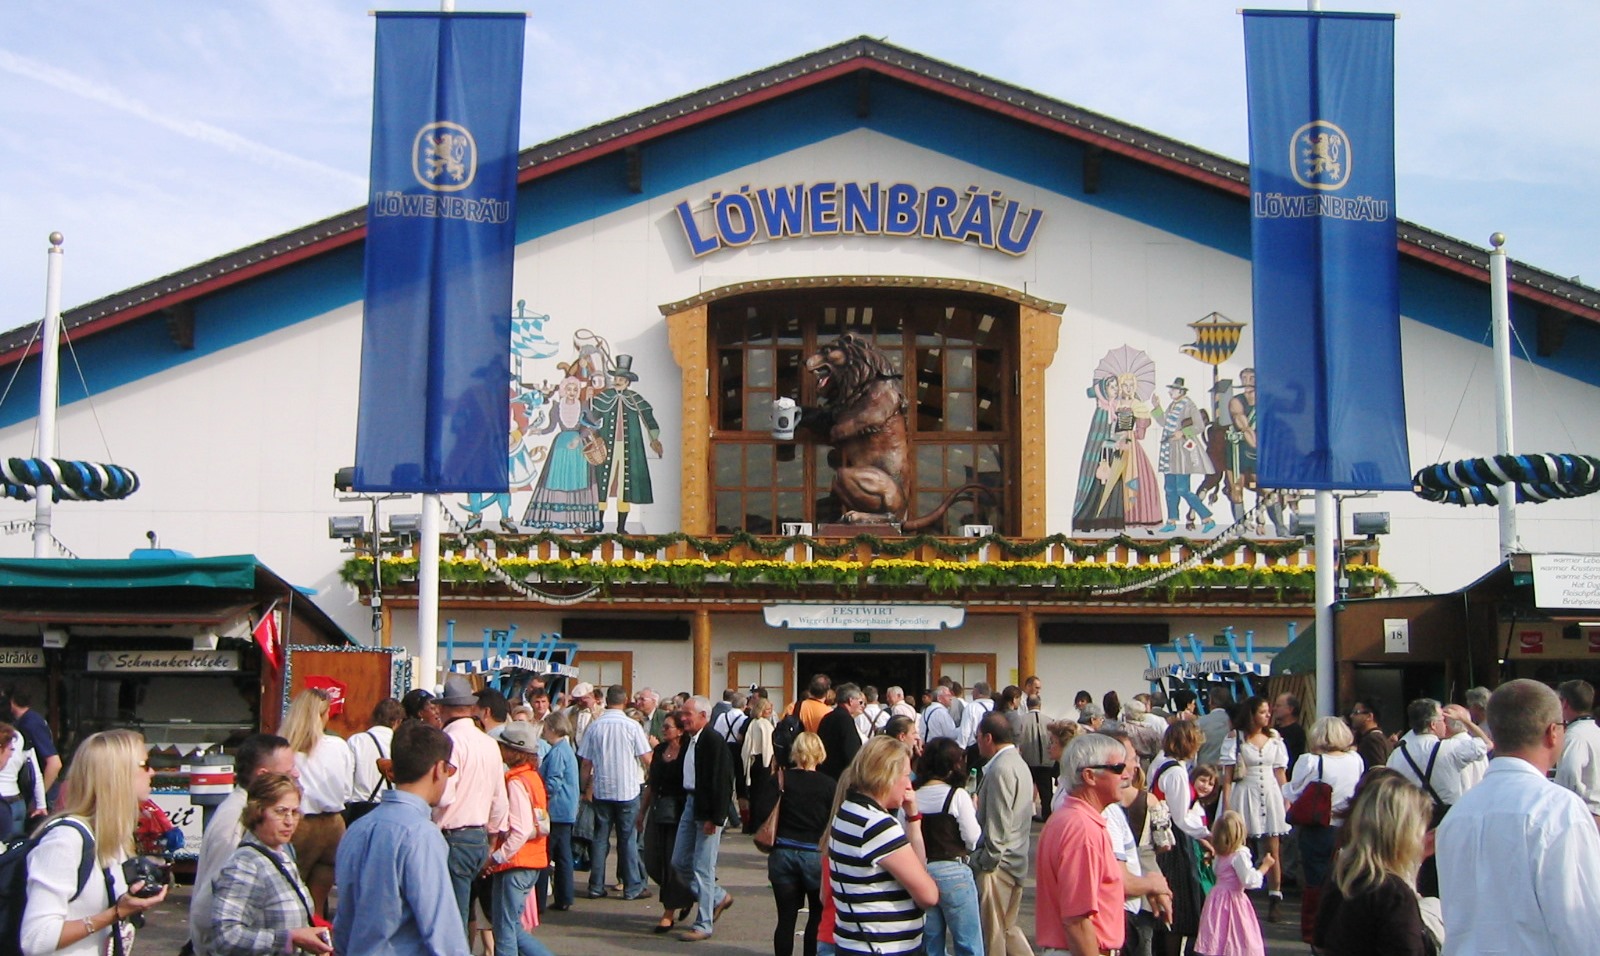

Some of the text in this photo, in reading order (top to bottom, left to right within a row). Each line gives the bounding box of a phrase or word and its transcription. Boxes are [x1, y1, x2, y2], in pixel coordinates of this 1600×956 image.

[375, 190, 510, 223] LÖWENBRÄU
[1254, 191, 1388, 222] LÖWENBRÄU
[675, 181, 1044, 258] LÖWENBRÄU
[832, 606, 895, 615] FESTWIRT
[1392, 631, 1403, 640] 18
[115, 654, 230, 668] Schmankerltheke
